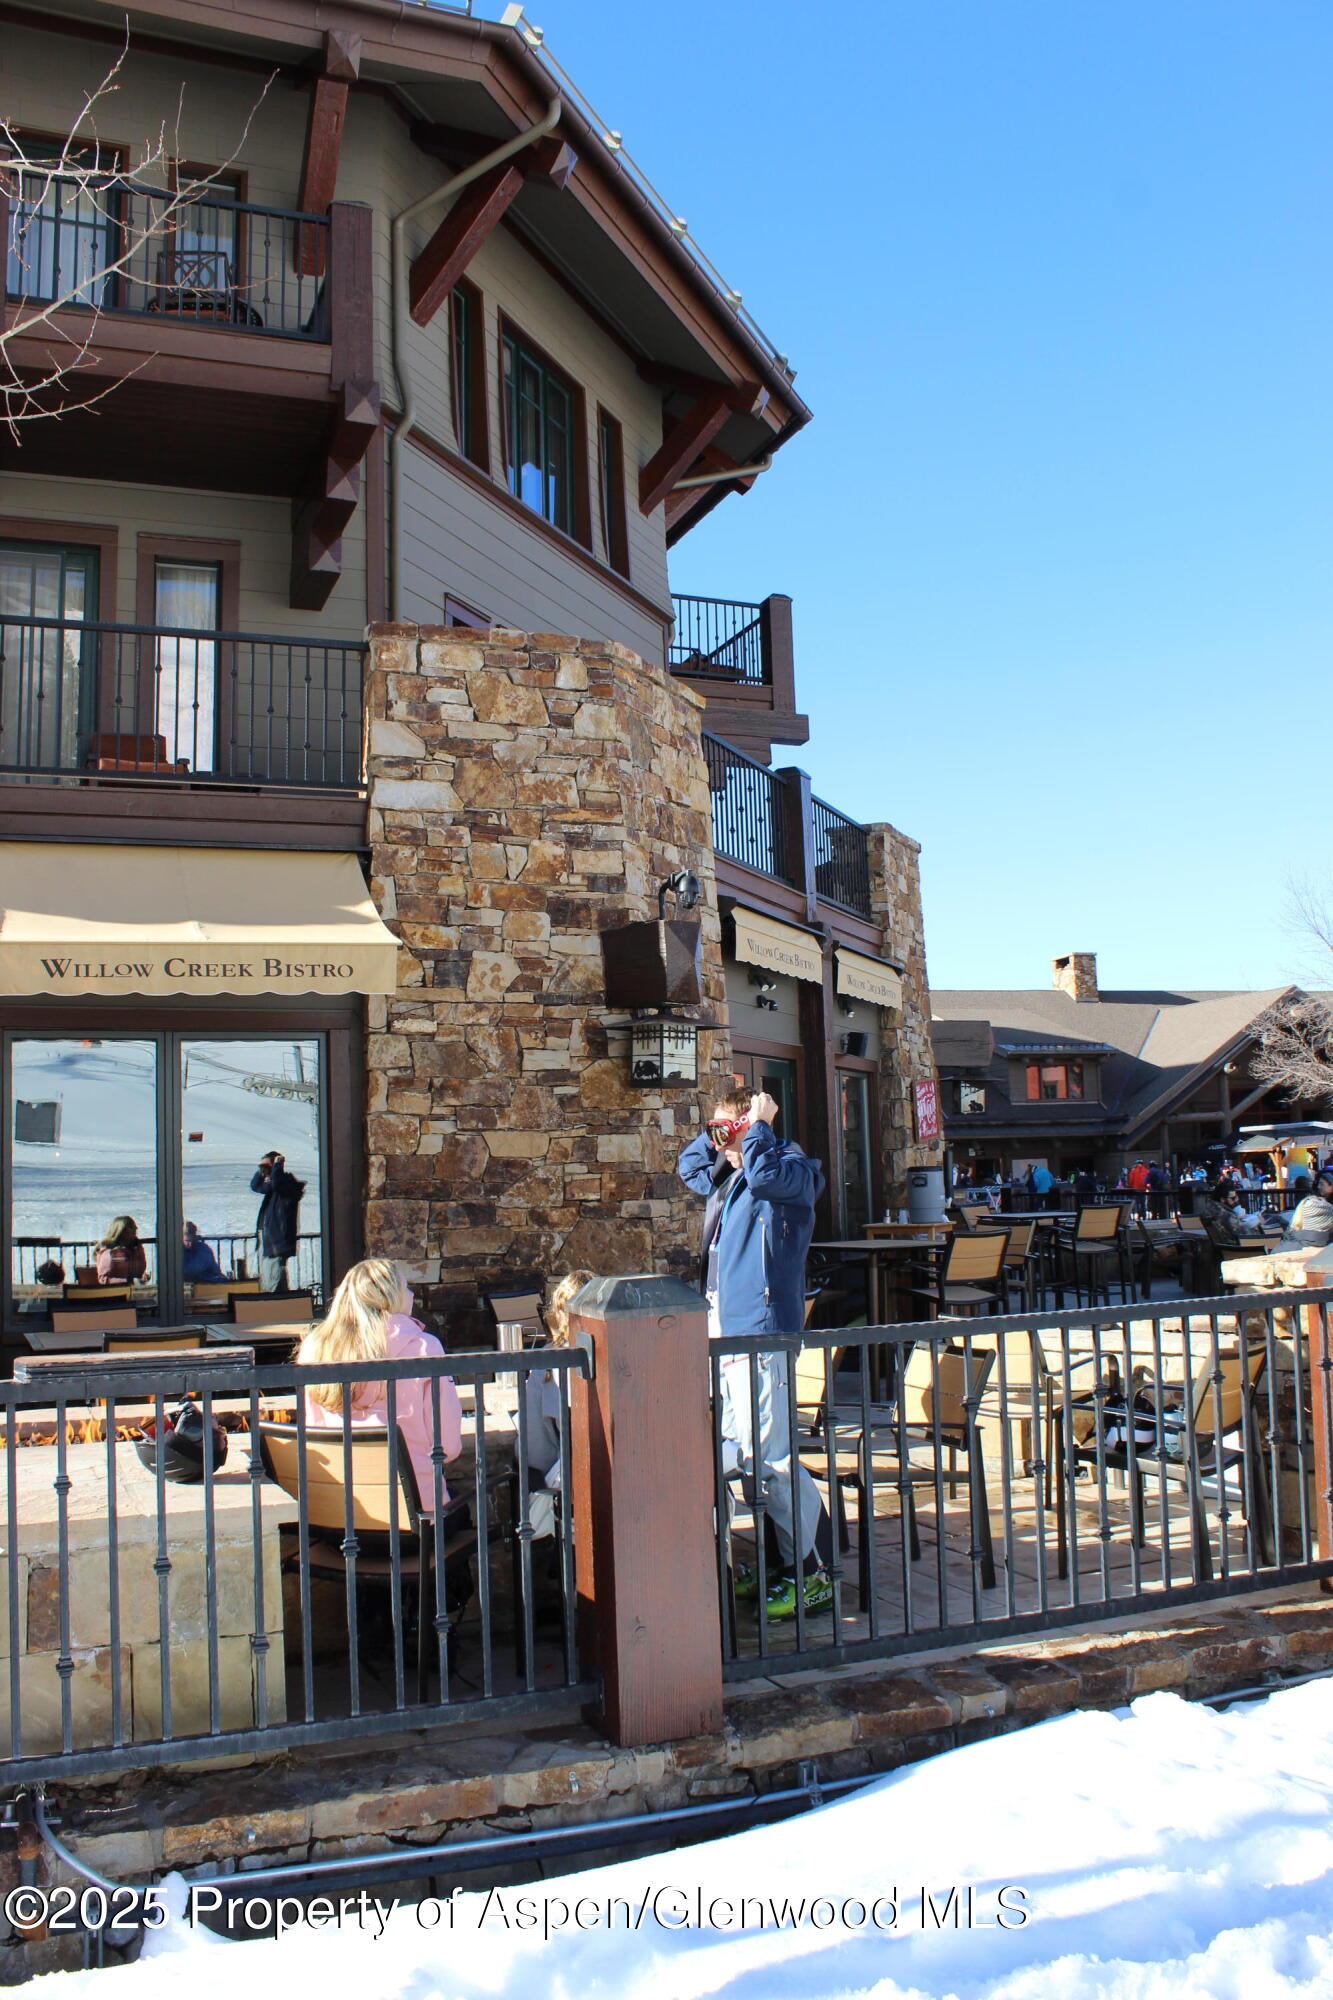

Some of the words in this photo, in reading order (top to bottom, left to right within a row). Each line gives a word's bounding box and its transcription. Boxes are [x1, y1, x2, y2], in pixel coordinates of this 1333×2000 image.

[40, 958, 155, 978] WILLOW
[163, 957, 254, 978] CREEK
[262, 958, 354, 978] BISTRO
